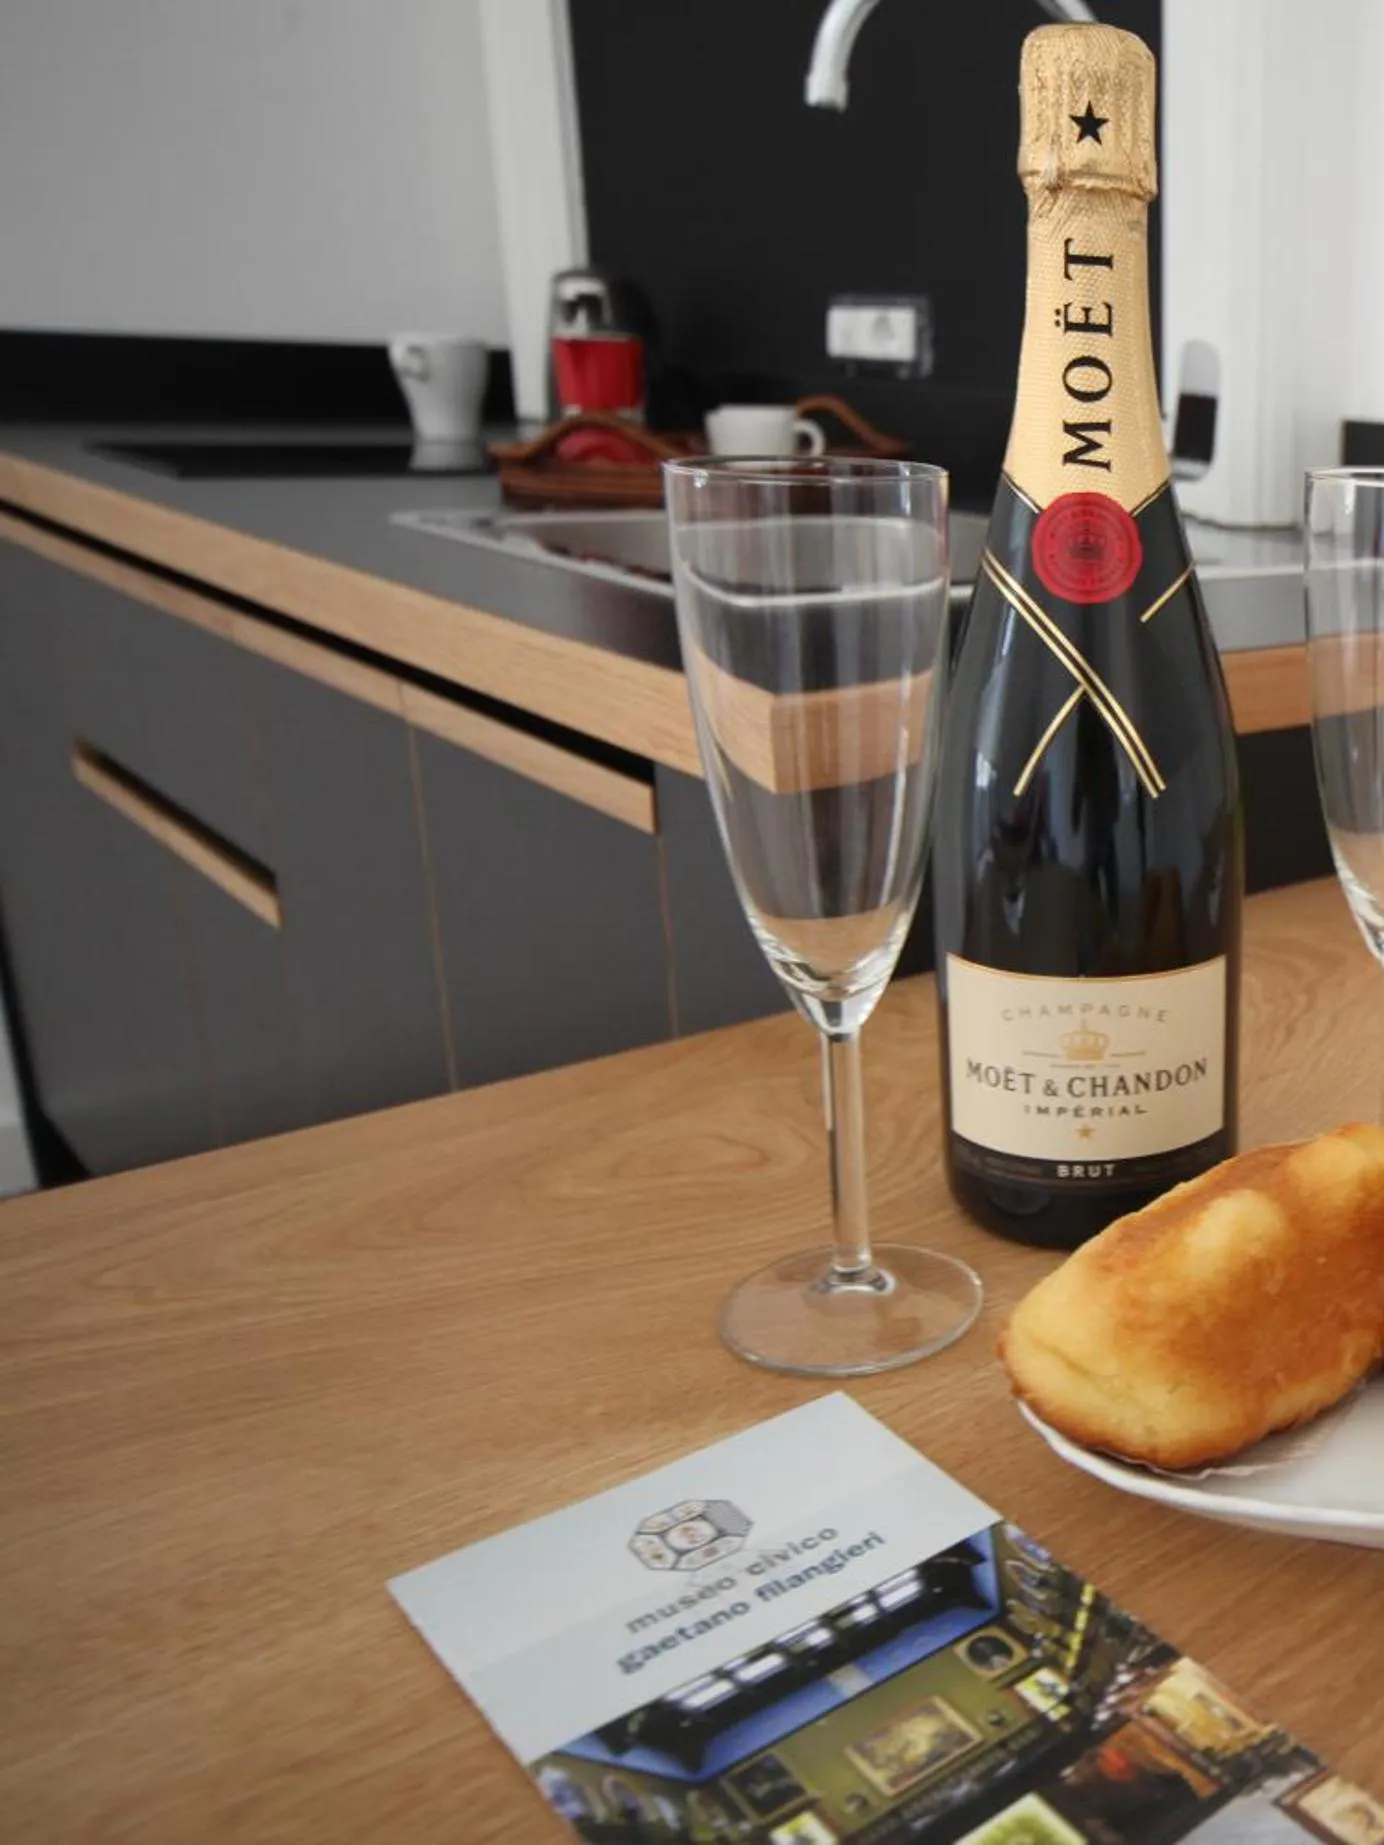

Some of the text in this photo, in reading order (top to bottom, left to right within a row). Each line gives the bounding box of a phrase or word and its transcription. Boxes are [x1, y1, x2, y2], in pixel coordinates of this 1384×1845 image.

[1054, 238, 1113, 472] MOËT
[1001, 1004, 1169, 1023] CHAMPAGNE
[966, 1057, 1208, 1098] MOËT & CHANDON
[1023, 1104, 1149, 1118] IMPÉRIAL
[1056, 1163, 1115, 1178] BRUT
[625, 1526, 838, 1634] museo civico
[616, 1531, 886, 1675] gaetano filangieri
